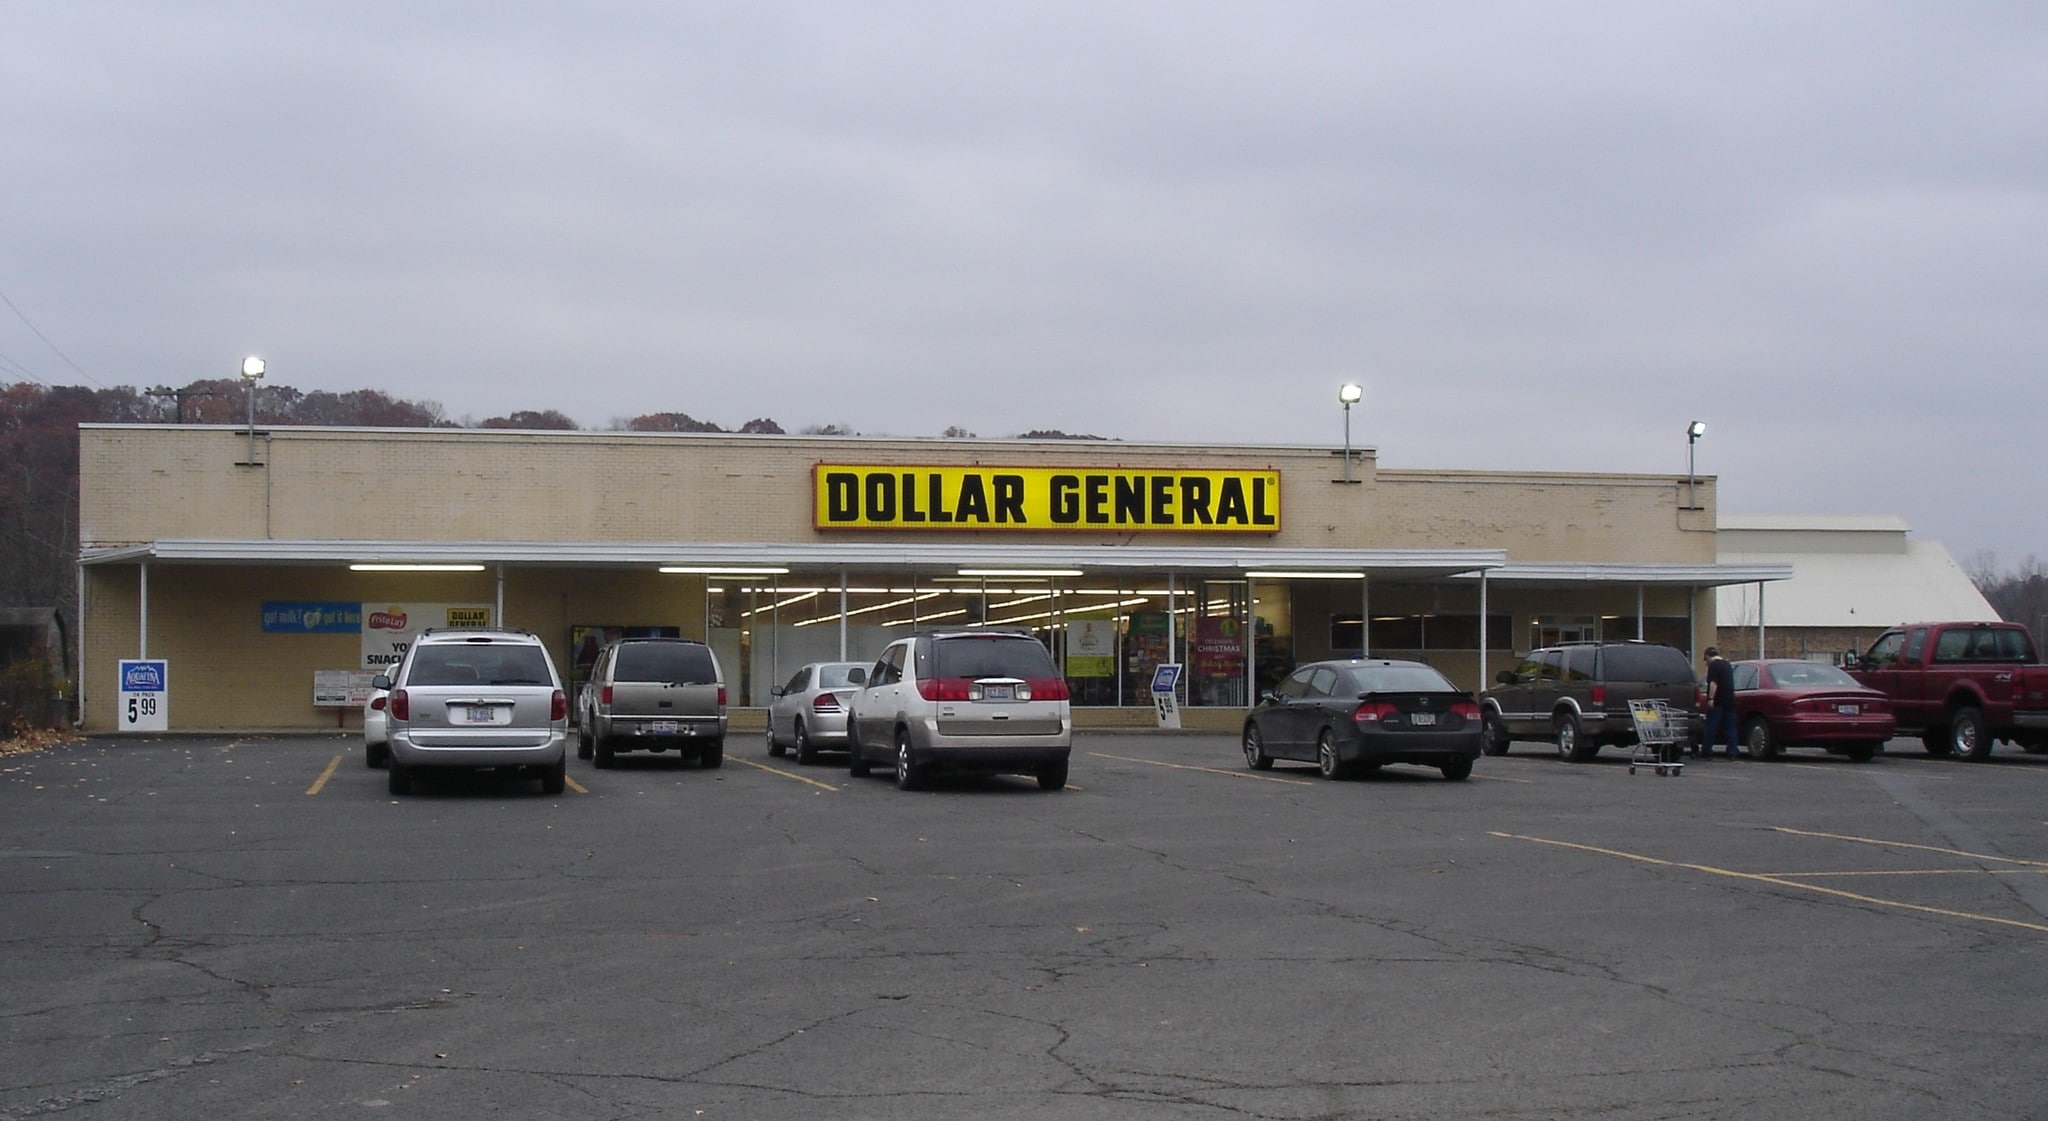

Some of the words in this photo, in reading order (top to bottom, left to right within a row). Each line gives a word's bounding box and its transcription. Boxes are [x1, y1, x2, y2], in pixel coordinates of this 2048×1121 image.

[826, 472, 1027, 524] DOLLAR
[1048, 474, 1275, 526] GENERAL
[451, 611, 485, 621] DOLLAR
[392, 642, 411, 652] YO
[1197, 644, 1240, 653] CHRISTMAS
